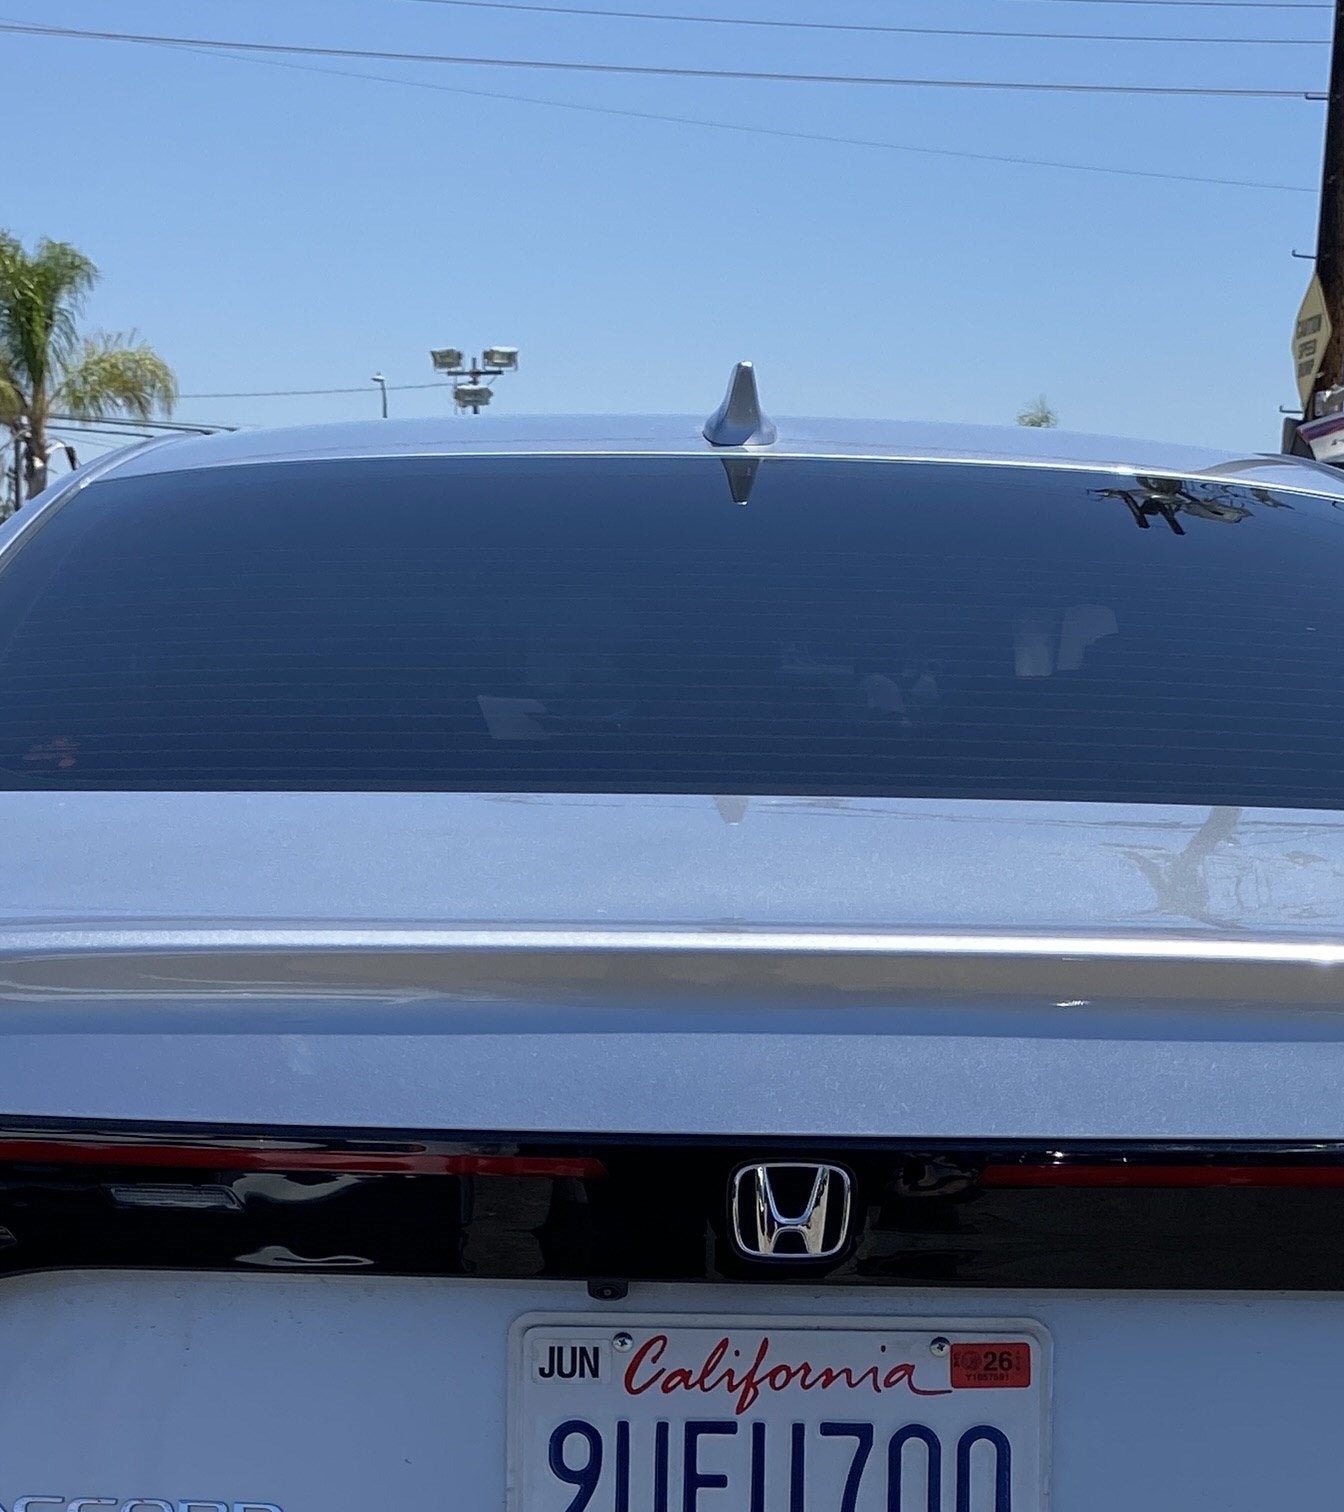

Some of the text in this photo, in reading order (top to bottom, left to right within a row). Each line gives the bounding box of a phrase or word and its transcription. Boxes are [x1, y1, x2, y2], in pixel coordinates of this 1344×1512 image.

[539, 1345, 600, 1379] JUN
[623, 1334, 953, 1415] California
[983, 1350, 1013, 1372] 26
